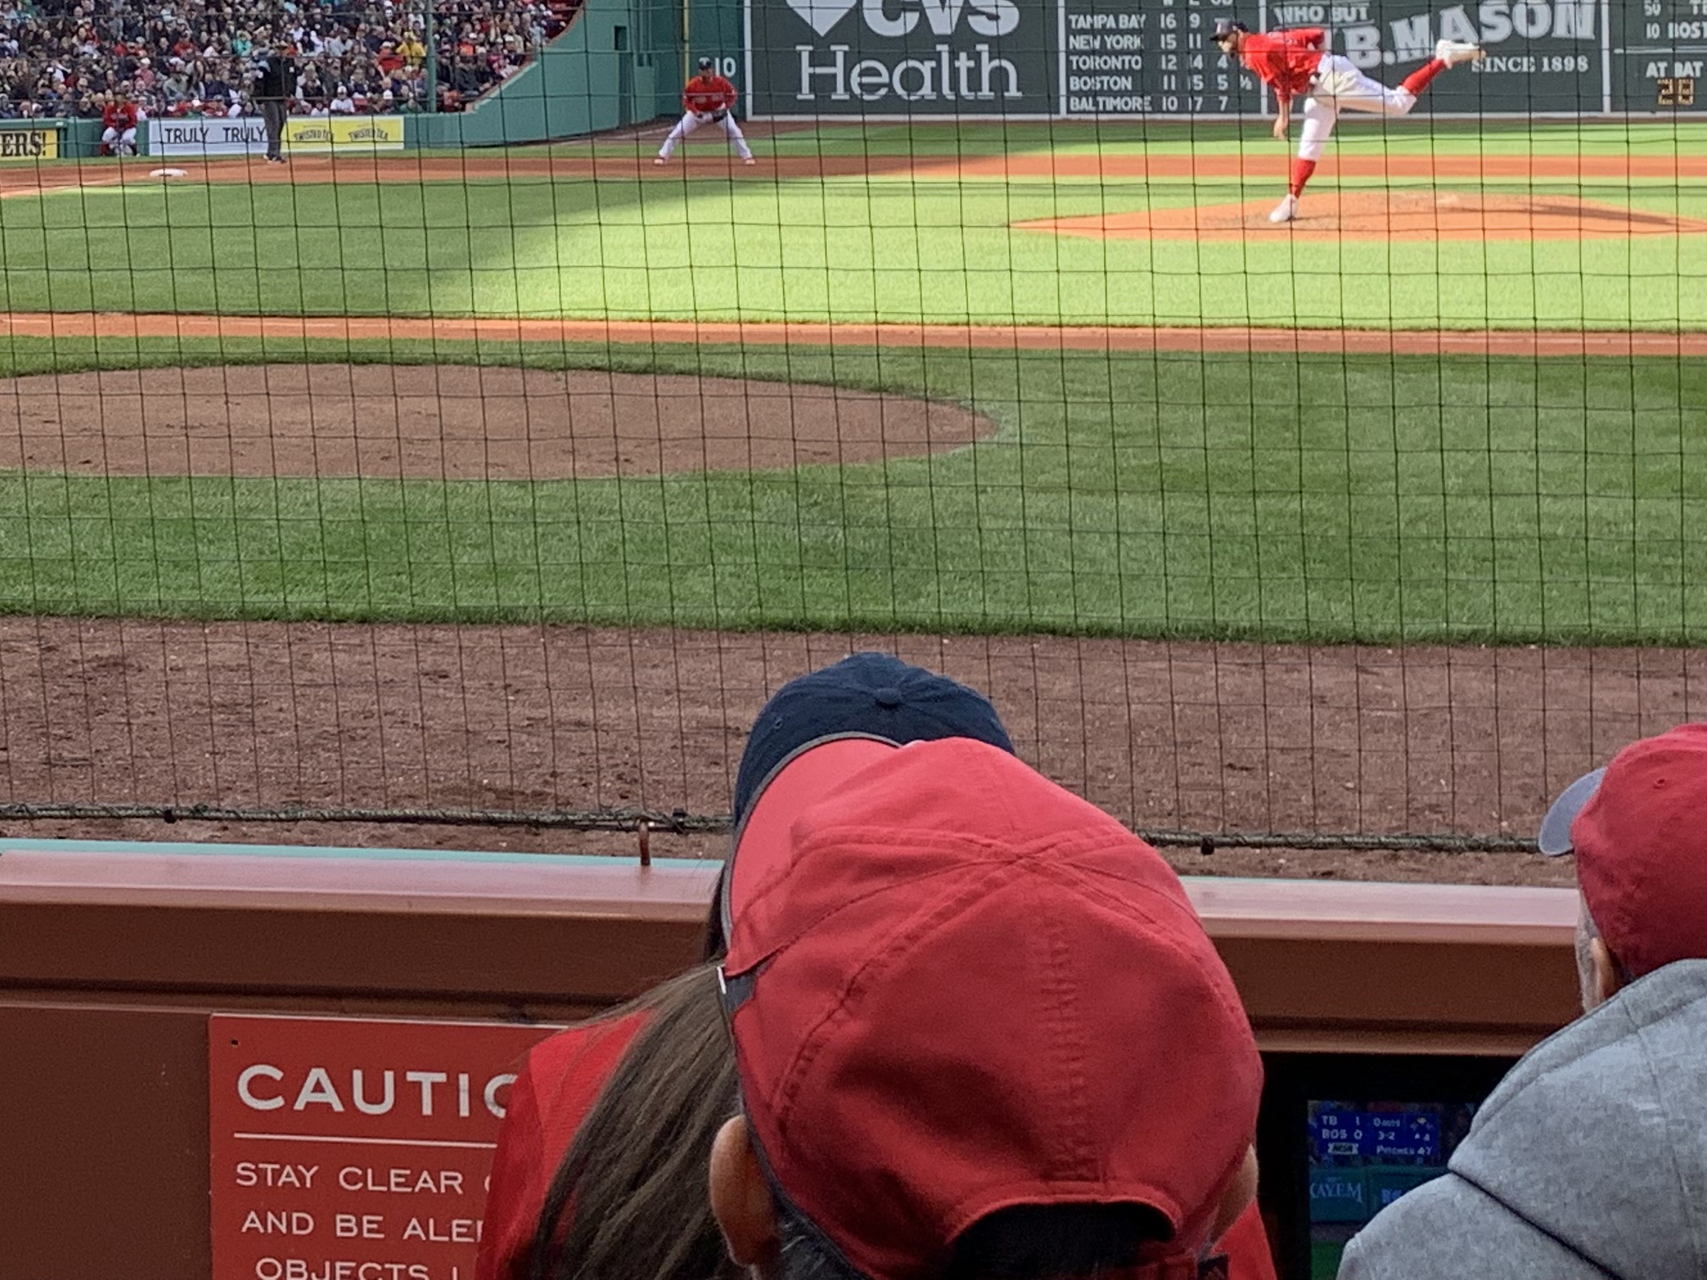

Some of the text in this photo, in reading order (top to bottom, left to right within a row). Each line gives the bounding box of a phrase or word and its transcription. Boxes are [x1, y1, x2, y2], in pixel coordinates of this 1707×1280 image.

[1068, 13, 1201, 30] TAMPA BAY 16 9
[1273, 4, 1370, 23] WHO BUT
[1069, 33, 1202, 50] NEW YORK 15 11
[1069, 55, 1143, 71] TORONTO
[1160, 54, 1177, 70] 12
[1217, 54, 1228, 69] 4
[1471, 54, 1590, 74] SINCE 1898
[1646, 61, 1704, 78] AT BAT
[795, 43, 1024, 102] Health
[1069, 75, 1133, 91] BOSTON
[1163, 75, 1176, 90] 11
[1217, 75, 1228, 91] 5
[1069, 95, 1152, 111] BALTIMORE
[1162, 95, 1178, 111] 10
[165, 126, 268, 144] TRULY TRULY
[236, 1063, 520, 1120] CAUTIO
[1321, 1115, 1338, 1126] TB
[1321, 1128, 1348, 1140] BOS
[235, 1162, 320, 1189] STAY
[337, 1166, 465, 1195] CLEAR
[241, 1210, 484, 1243] AND BE ALE
[255, 1256, 429, 1280] OBJECTS
